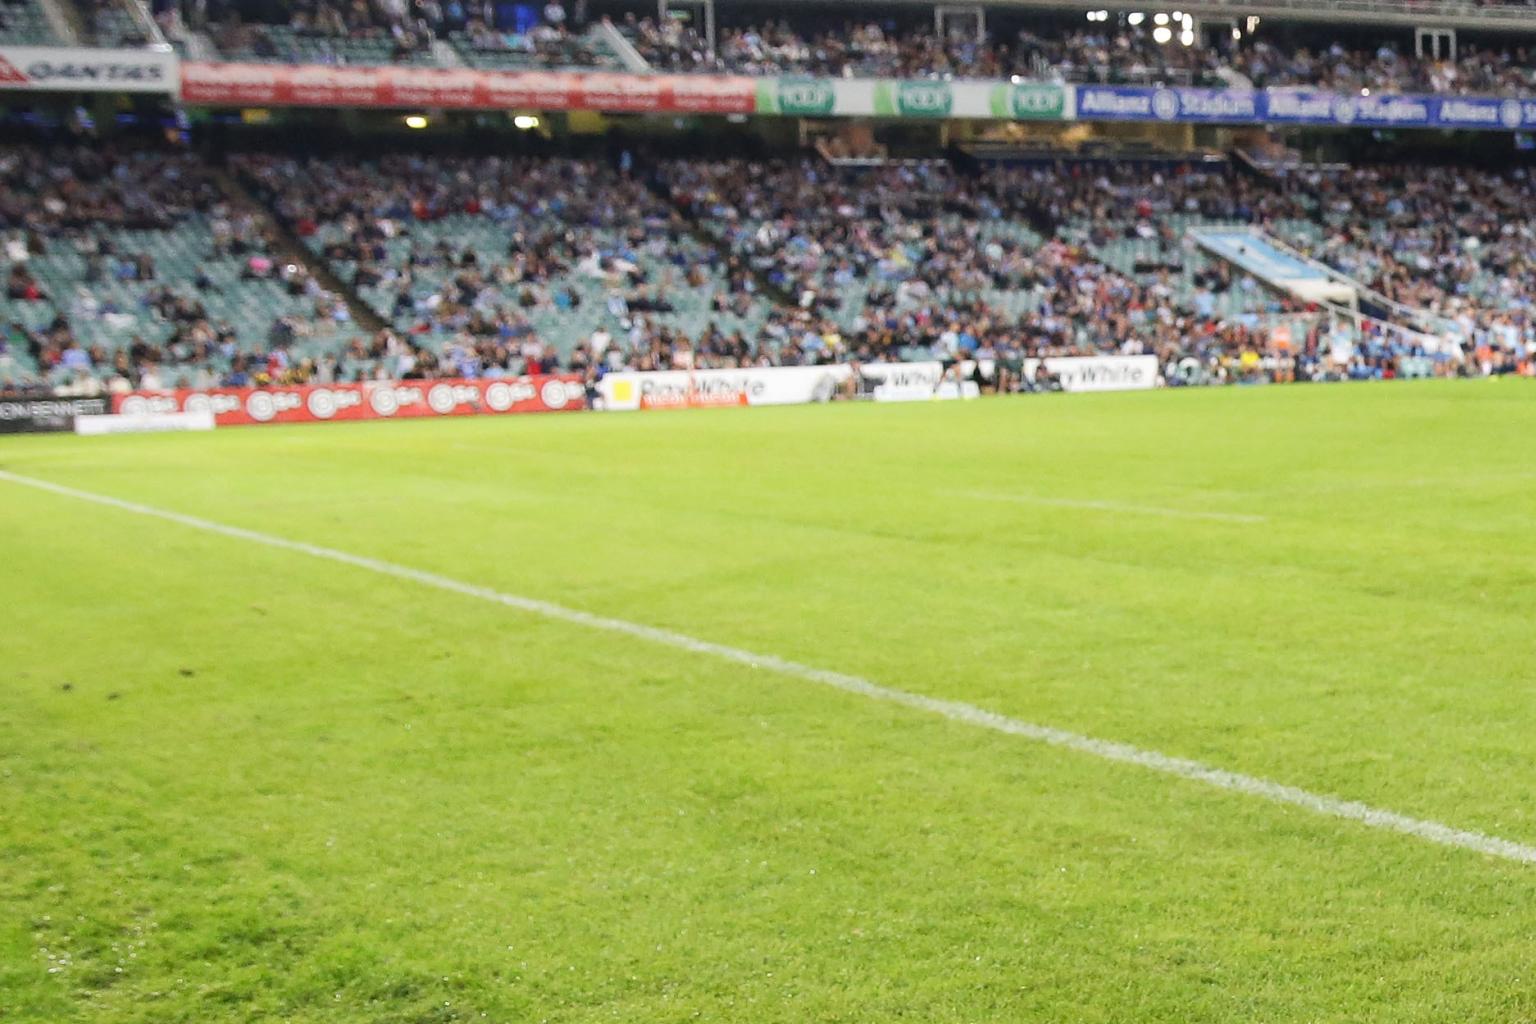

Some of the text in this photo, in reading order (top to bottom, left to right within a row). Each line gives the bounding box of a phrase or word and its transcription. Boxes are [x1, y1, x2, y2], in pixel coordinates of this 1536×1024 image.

[27, 60, 163, 80] QANTAS
[1081, 91, 1254, 116] Allianz Stadium
[1267, 94, 1426, 120] Allianz Stadium
[1438, 102, 1497, 123] Allianz
